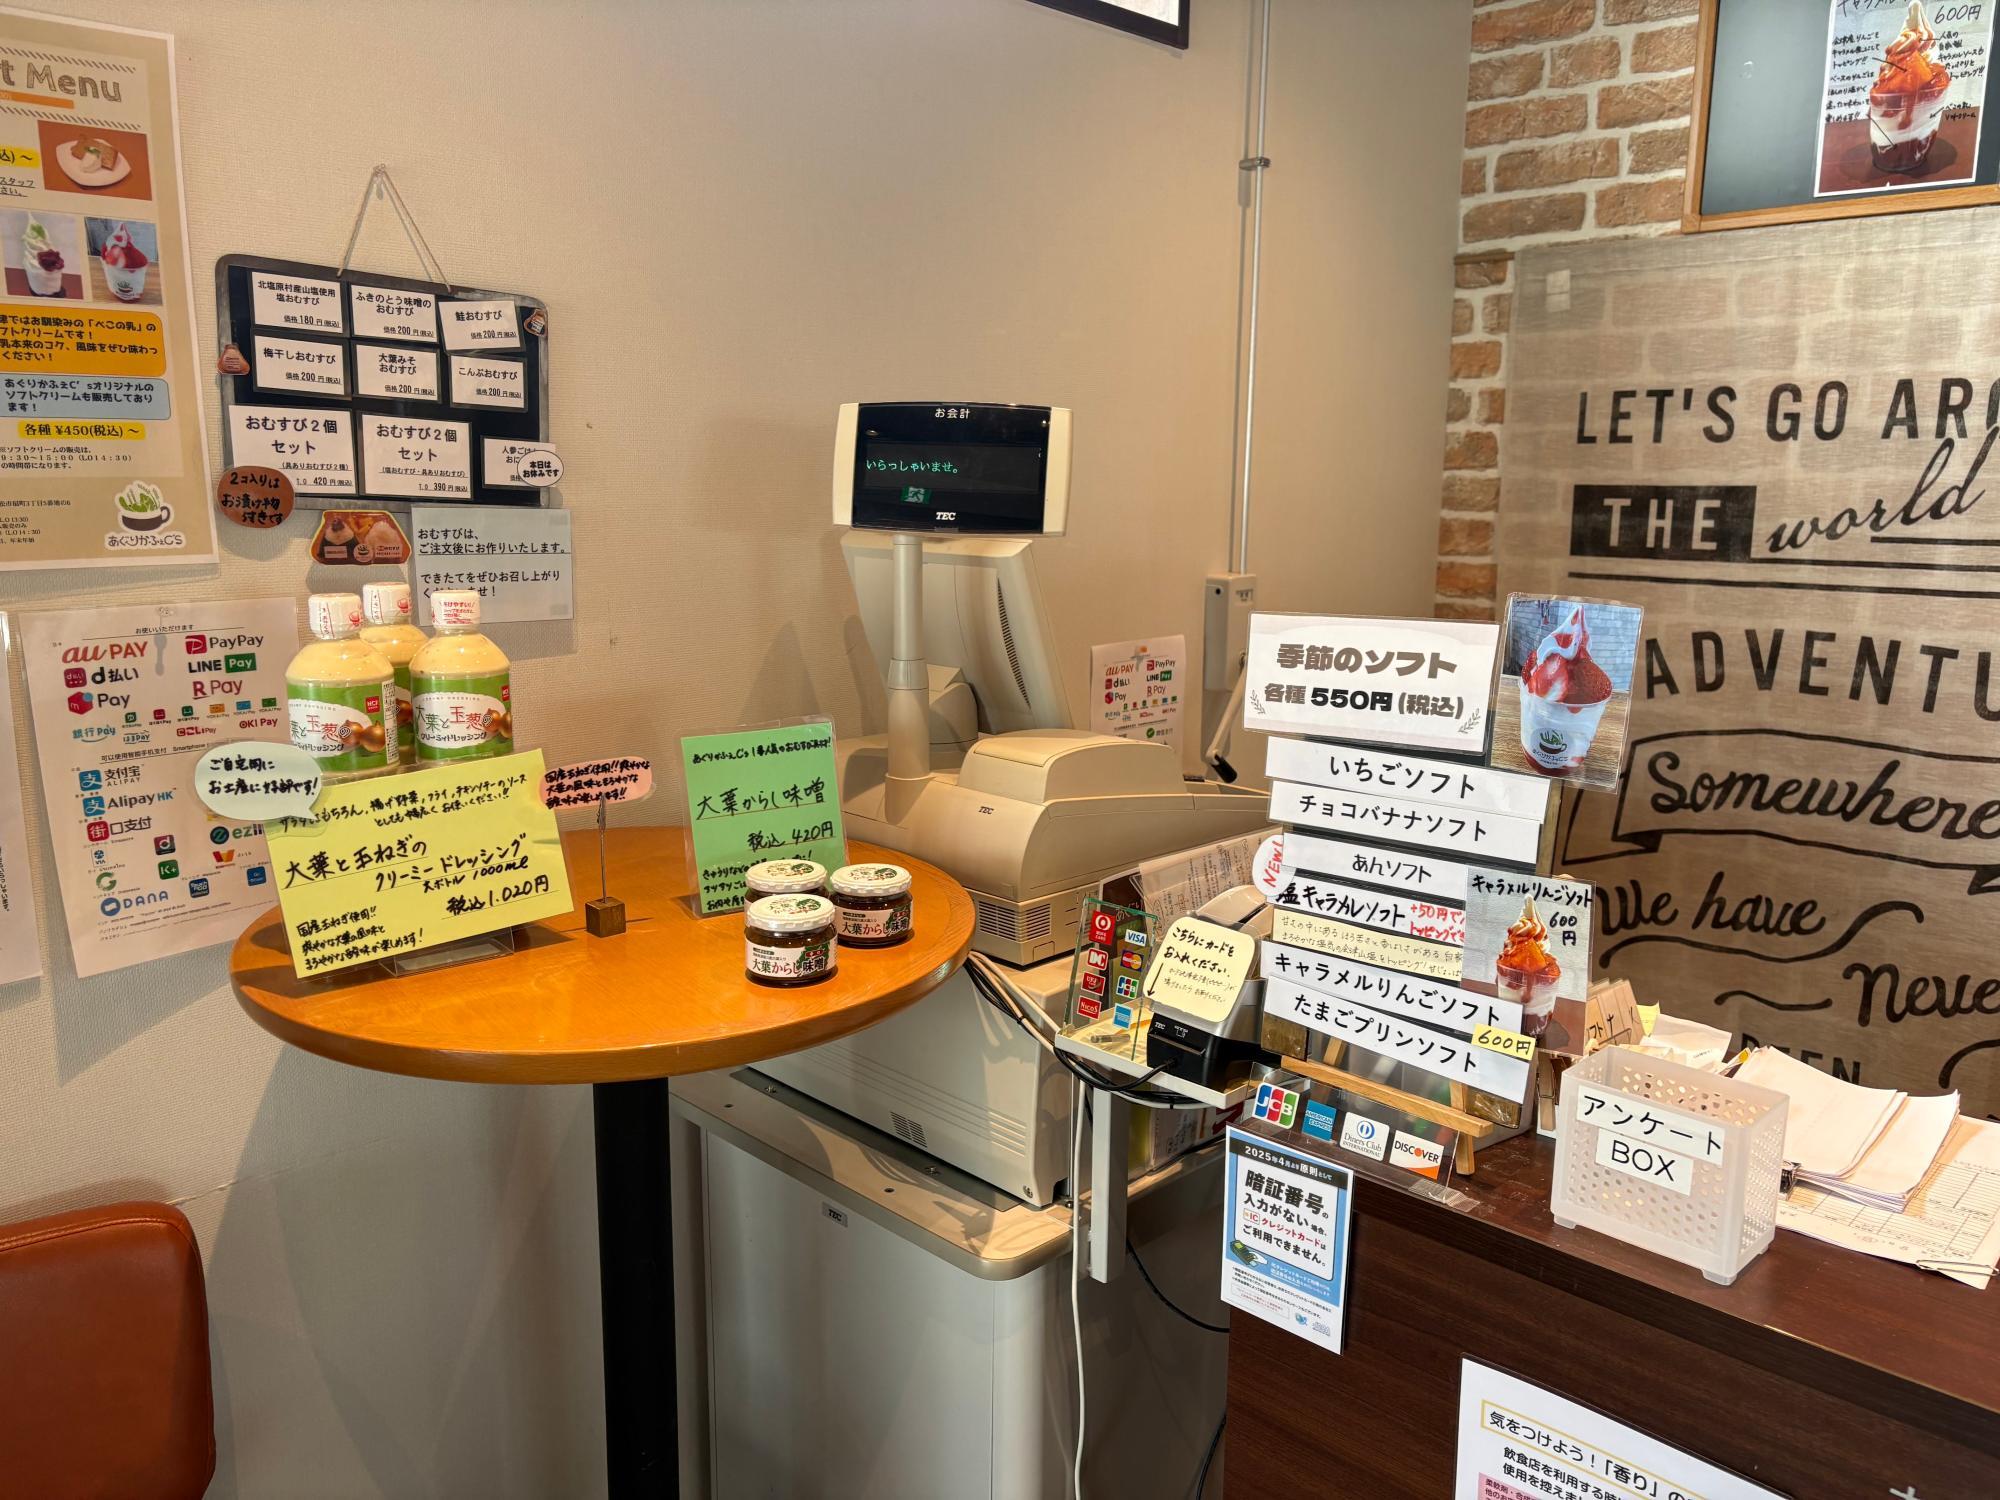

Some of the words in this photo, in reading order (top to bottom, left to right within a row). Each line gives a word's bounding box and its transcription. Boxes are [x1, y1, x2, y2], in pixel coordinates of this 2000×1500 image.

[1935, 5, 1981, 24] 600円
[26, 62, 122, 102] Menu
[276, 293, 320, 306] 塩おむすび
[356, 292, 432, 309] ふきのとう味噌の
[376, 304, 414, 316] おむすび
[455, 309, 502, 321] 鮭おむすび
[263, 347, 336, 364] 梅干しおむすび
[378, 353, 416, 365] 大葉みそ
[378, 363, 417, 375] おむすび
[458, 366, 518, 380] こんぶおむすび
[935, 408, 970, 419] お会計
[1577, 385, 1738, 444] LET'S
[1765, 380, 1849, 442] GO
[25, 424, 52, 436] 各種
[245, 415, 338, 434] おむすび２個
[376, 424, 458, 443] おむすび２個
[271, 440, 316, 455] セット
[398, 447, 438, 461] セット
[529, 460, 552, 469] 本日は
[866, 459, 959, 474] いらっしゃいませ。
[313, 477, 328, 486] 420
[523, 469, 559, 478] お休みです
[433, 482, 446, 492] 390
[1603, 498, 1722, 551] THE
[1765, 426, 2000, 553] world
[936, 512, 956, 520] TEC
[417, 527, 479, 540] おむすびは、
[419, 542, 568, 555] ご注文後にお作りいたします。
[420, 570, 560, 584] できたてをぜひお召し上がり
[209, 634, 264, 649] PayPay
[61, 643, 108, 663] au
[109, 641, 148, 659] PAY
[187, 660, 222, 673] LINE
[228, 656, 252, 670] Pay
[1120, 664, 1134, 673] PAY
[1155, 659, 1175, 668] PayPay
[1276, 642, 1457, 680] 季節のソフト
[91, 666, 139, 685] d払い
[210, 679, 243, 696] Pay
[1153, 685, 1166, 695] Pay
[97, 693, 131, 709] Pay
[1114, 692, 1126, 701] Pay
[1264, 682, 1306, 705] 各種
[1310, 687, 1393, 712] 550円
[1397, 694, 1464, 720] (税込)
[261, 718, 278, 728] Pay
[104, 765, 141, 781] 支付宝
[210, 757, 275, 772] ご自宅用に
[107, 777, 141, 787] ALIPAY
[1329, 755, 1476, 799] いちごソフト
[107, 794, 155, 810] Alipay
[157, 790, 173, 801] HK
[696, 776, 825, 820] 大葉からし味噌
[1647, 750, 2000, 840] Somewhere
[978, 806, 994, 814] TEC
[1299, 794, 1487, 843] チョコバナナソフト
[747, 832, 785, 853] 税込
[791, 820, 834, 846] 420円
[285, 834, 428, 889] 大葉と玉ねぎの
[1351, 853, 1432, 885] あんソフト
[423, 875, 465, 893] 大ボトル
[1471, 873, 1593, 907] キャラメルりんごソフト
[123, 890, 169, 909] DANA
[446, 895, 485, 916] 税込
[1276, 882, 1406, 929] 塩キャラメルソフト
[1692, 871, 1827, 938] have
[1410, 903, 1465, 924] +50円で
[1549, 911, 1578, 928] 600
[1127, 932, 1145, 944] VISA
[1172, 927, 1234, 957] こちらにカードを
[1562, 931, 1577, 947] 円
[1089, 951, 1105, 967] DC
[1275, 952, 1500, 1026] キャラメルりんごソフト
[1294, 993, 1477, 1073] たまごプリンソフト
[1476, 1029, 1532, 1056] 600円
[1255, 1093, 1293, 1117] JCB
[1305, 1109, 1333, 1125] AMERICAN
[1308, 1119, 1333, 1132] EXPRESS
[1582, 1094, 1721, 1156] アンケート
[1342, 1142, 1381, 1157] INTERNATIONAL
[1344, 1132, 1365, 1146] Diners
[1366, 1140, 1382, 1152] Club
[1394, 1140, 1439, 1164] DISCOVER
[1610, 1139, 1676, 1183] BOX
[1244, 1169, 1329, 1219] 暗証番号の
[1261, 1217, 1327, 1250] クレジットカードは
[1242, 1224, 1327, 1267] ご利用できません。
